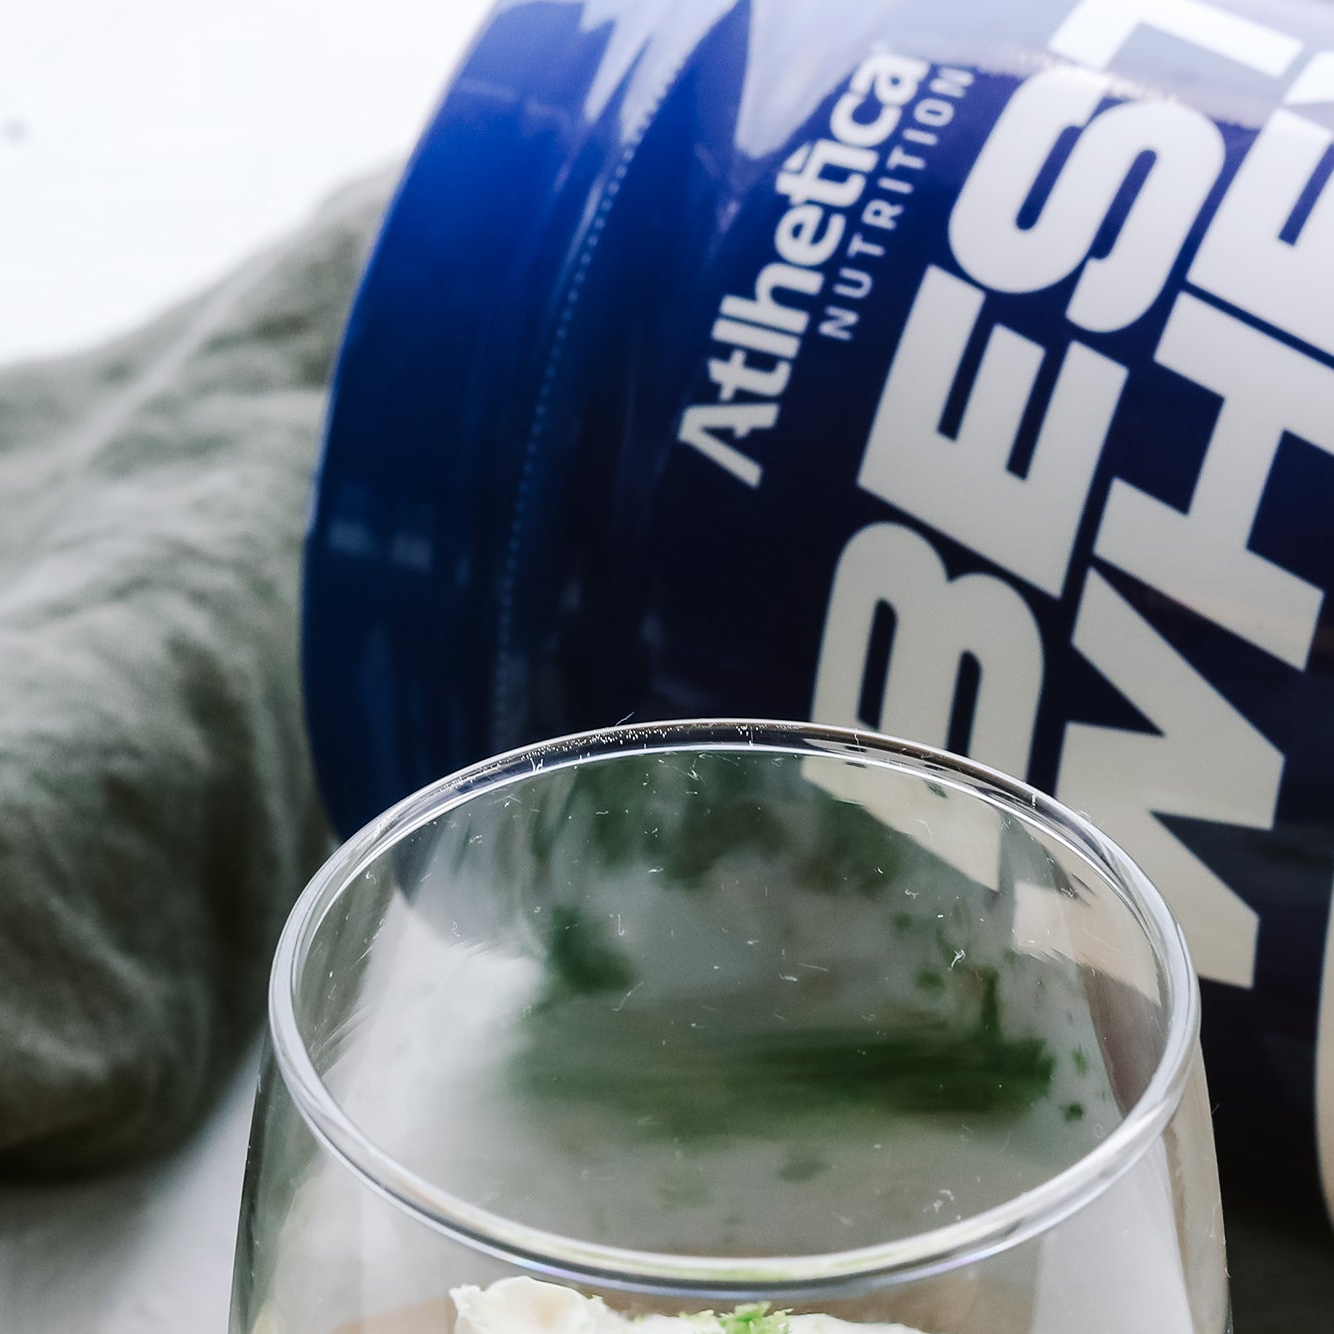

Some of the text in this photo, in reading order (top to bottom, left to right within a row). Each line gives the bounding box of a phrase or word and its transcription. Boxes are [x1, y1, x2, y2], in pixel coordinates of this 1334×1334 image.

[678, 53, 929, 489] Atlhetica
[818, 67, 975, 342] NUTRITION
[803, 0, 1304, 893] BEST
